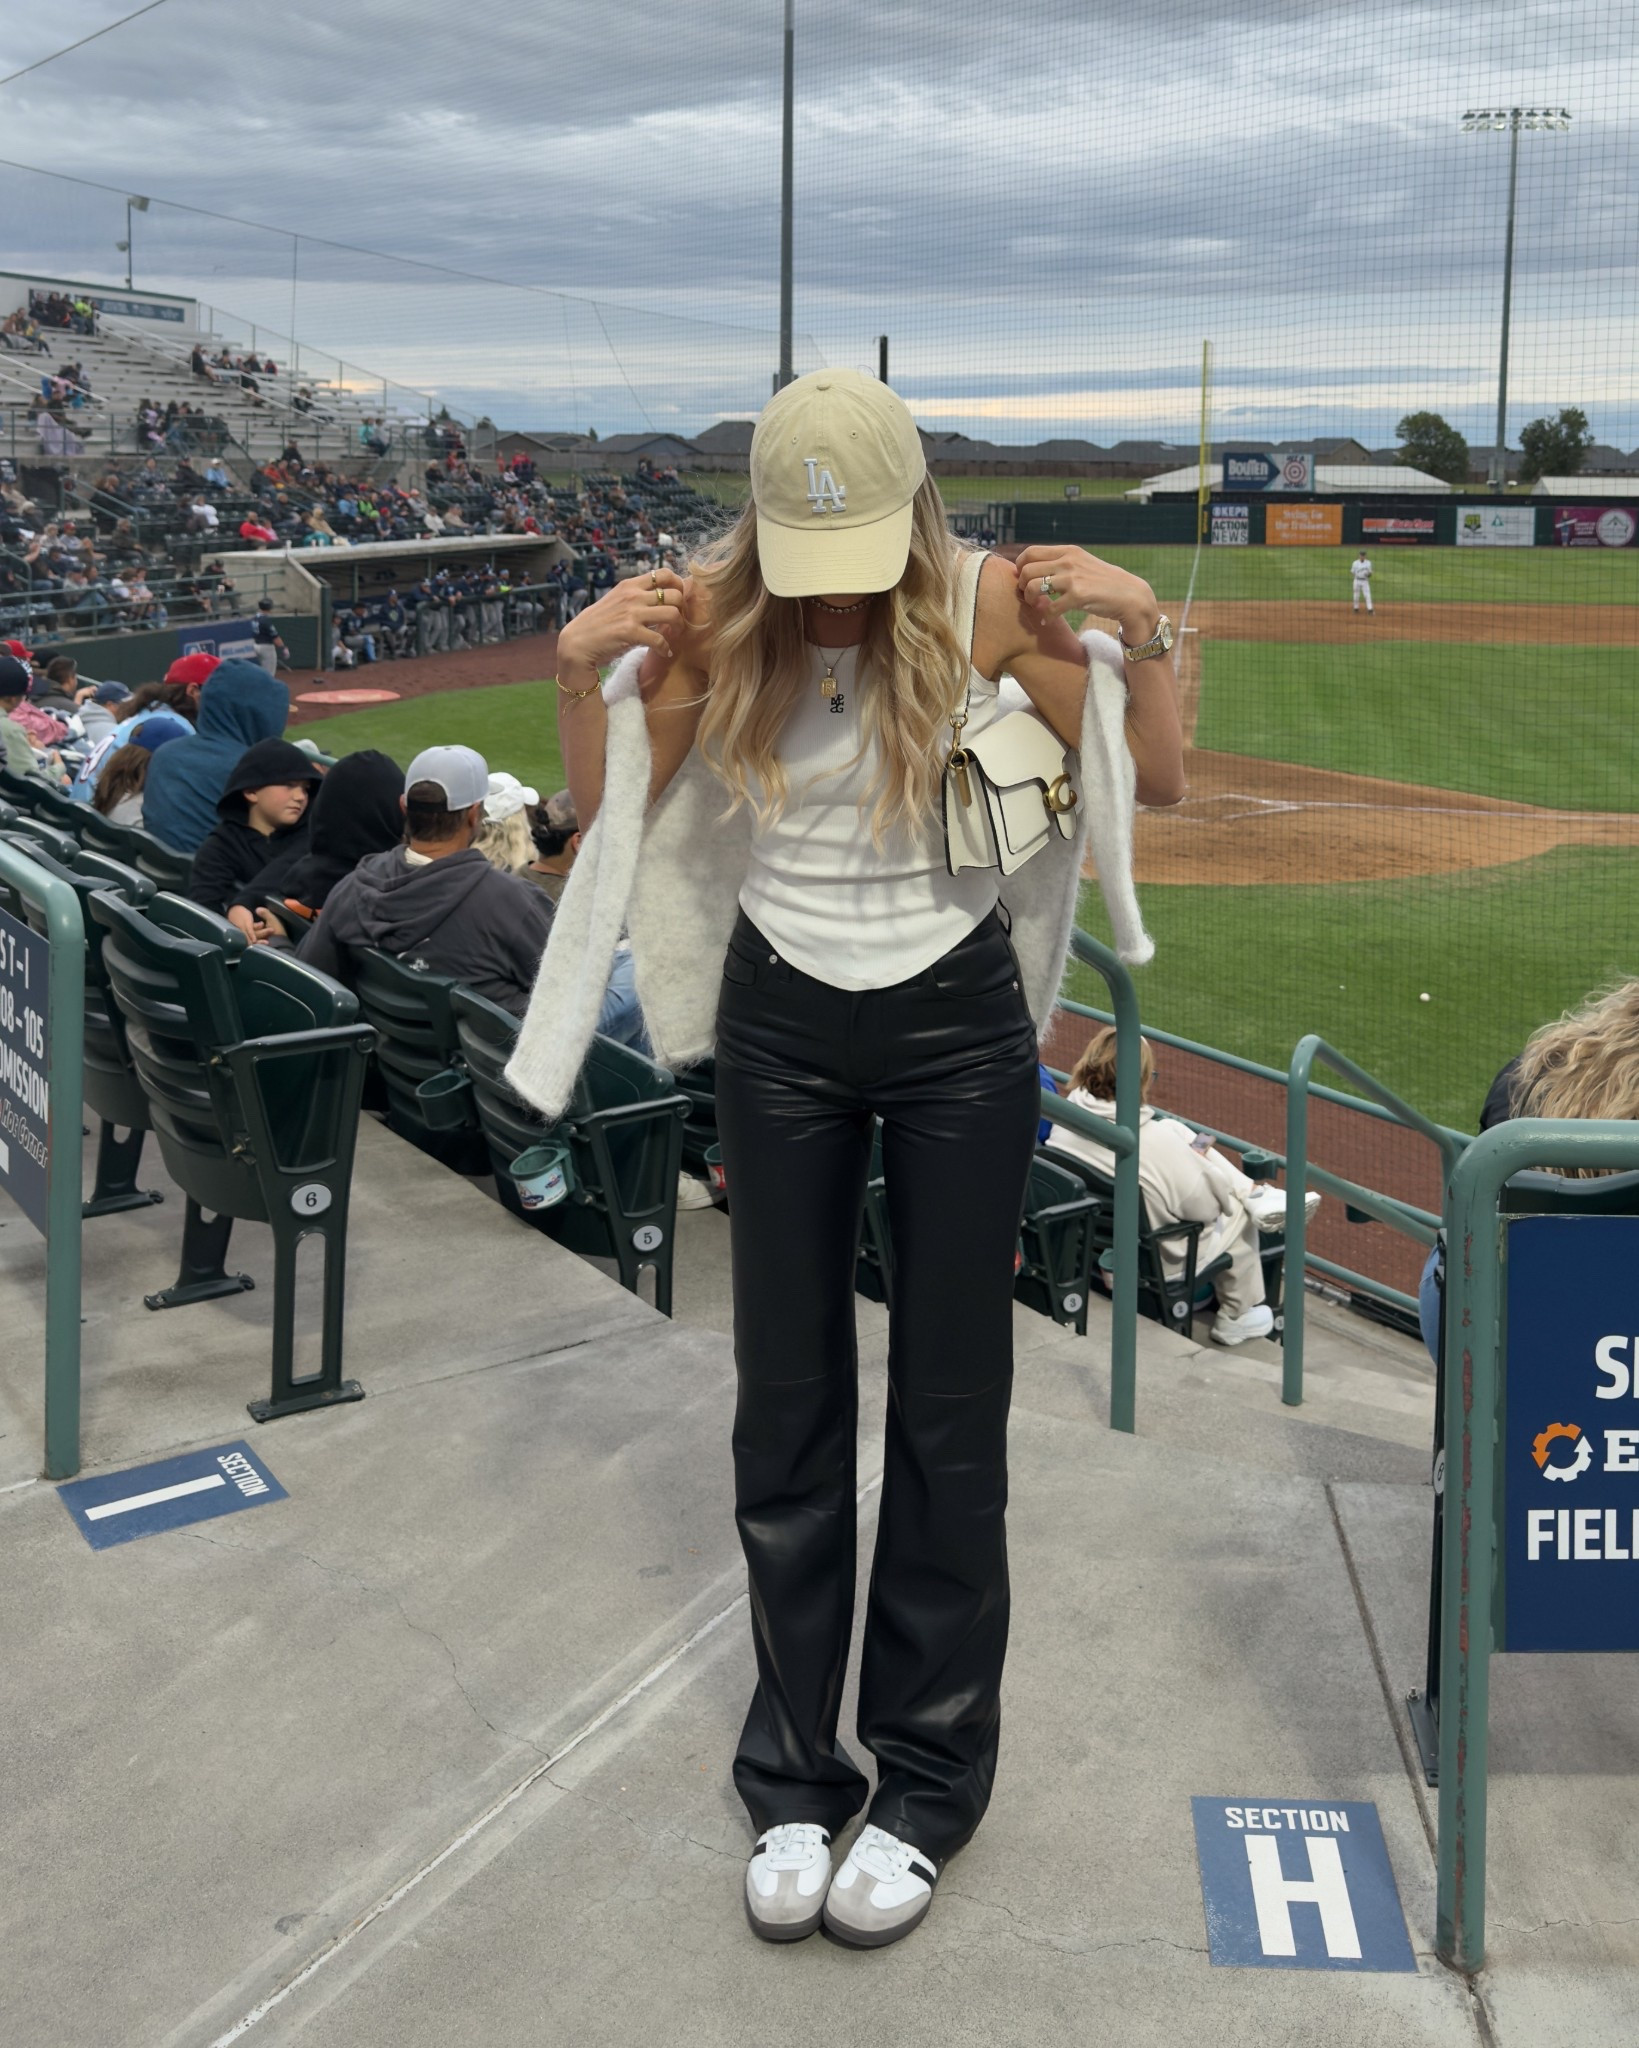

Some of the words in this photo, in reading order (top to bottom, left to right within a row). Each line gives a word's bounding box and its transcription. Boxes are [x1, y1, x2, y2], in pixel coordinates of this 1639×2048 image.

[803, 458, 846, 513] LA
[1221, 506, 1249, 517] KEPR
[1212, 521, 1248, 530] ACTION
[1212, 530, 1248, 542] NEWS
[306, 1191, 317, 1208] 6
[644, 1231, 653, 1245] 5
[1069, 1297, 1077, 1308] 3
[1595, 1335, 1639, 1400] S
[216, 1451, 270, 1497] SECTION
[1527, 1509, 1639, 1561] FIEL
[1225, 1806, 1350, 1832] SECTION
[1244, 1834, 1362, 1959] H
